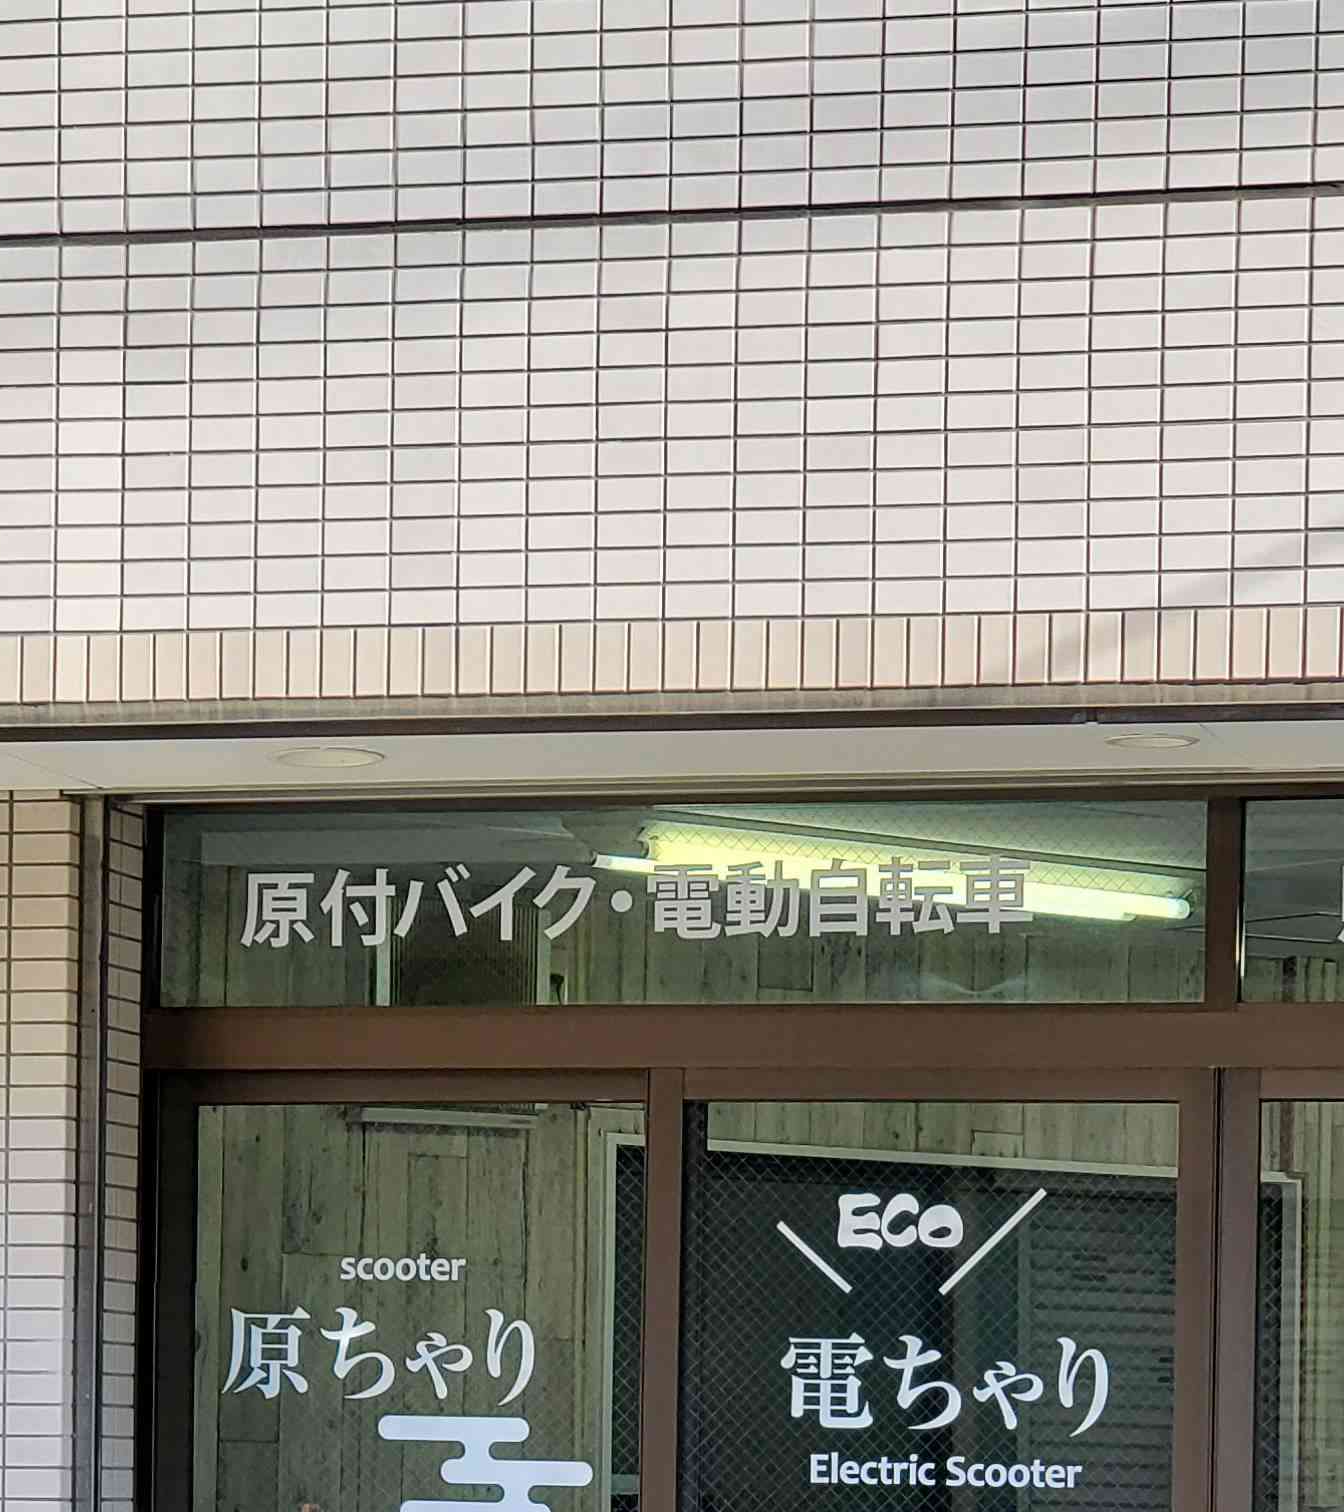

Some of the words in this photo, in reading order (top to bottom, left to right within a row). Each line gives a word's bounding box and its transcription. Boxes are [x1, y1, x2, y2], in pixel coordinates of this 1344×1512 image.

[239, 857, 1032, 948] 原付バイク・電動自転車
[339, 1252, 467, 1282] scooter
[221, 1305, 538, 1407] 原ちゃり
[780, 1333, 1111, 1438] 電ちゃり
[808, 1455, 936, 1488] Electric
[945, 1456, 1083, 1489] Scooter
